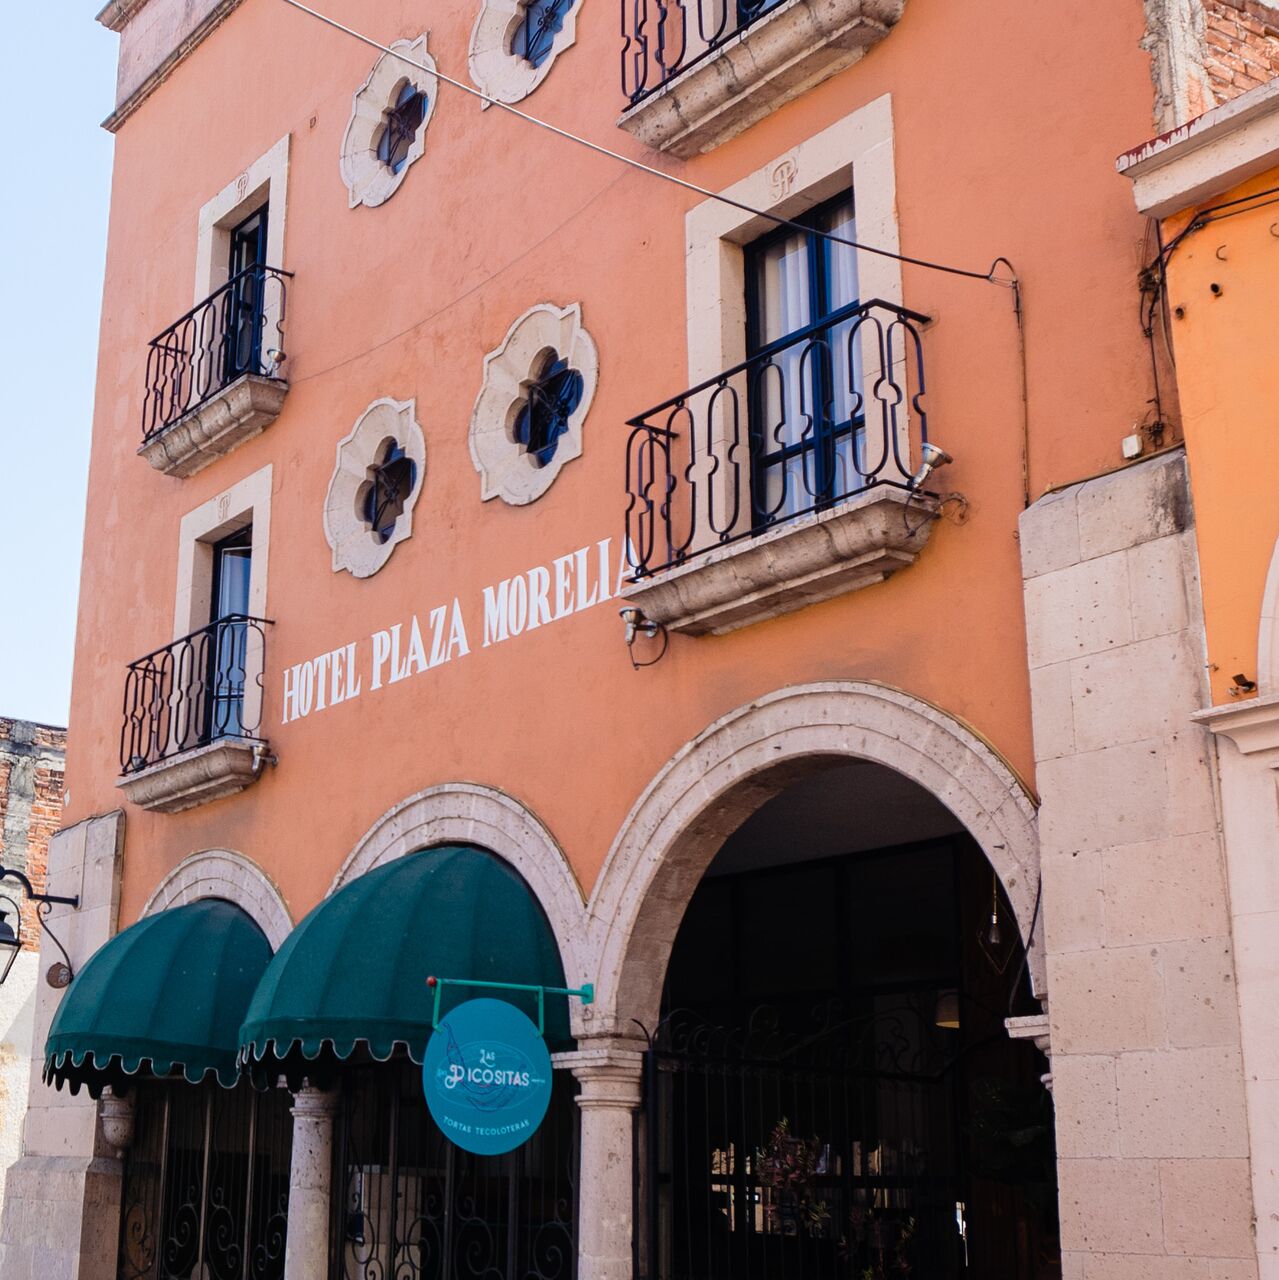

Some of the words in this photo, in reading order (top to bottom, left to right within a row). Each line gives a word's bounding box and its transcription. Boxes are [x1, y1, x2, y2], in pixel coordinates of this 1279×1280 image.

[281, 642, 361, 724] HOTEL
[370, 597, 471, 691] PLAZA
[482, 533, 646, 648] MORELIA
[480, 1049, 496, 1068] LAS
[444, 1064, 530, 1089] PICOSITAS
[443, 1116, 471, 1133] TORTAS
